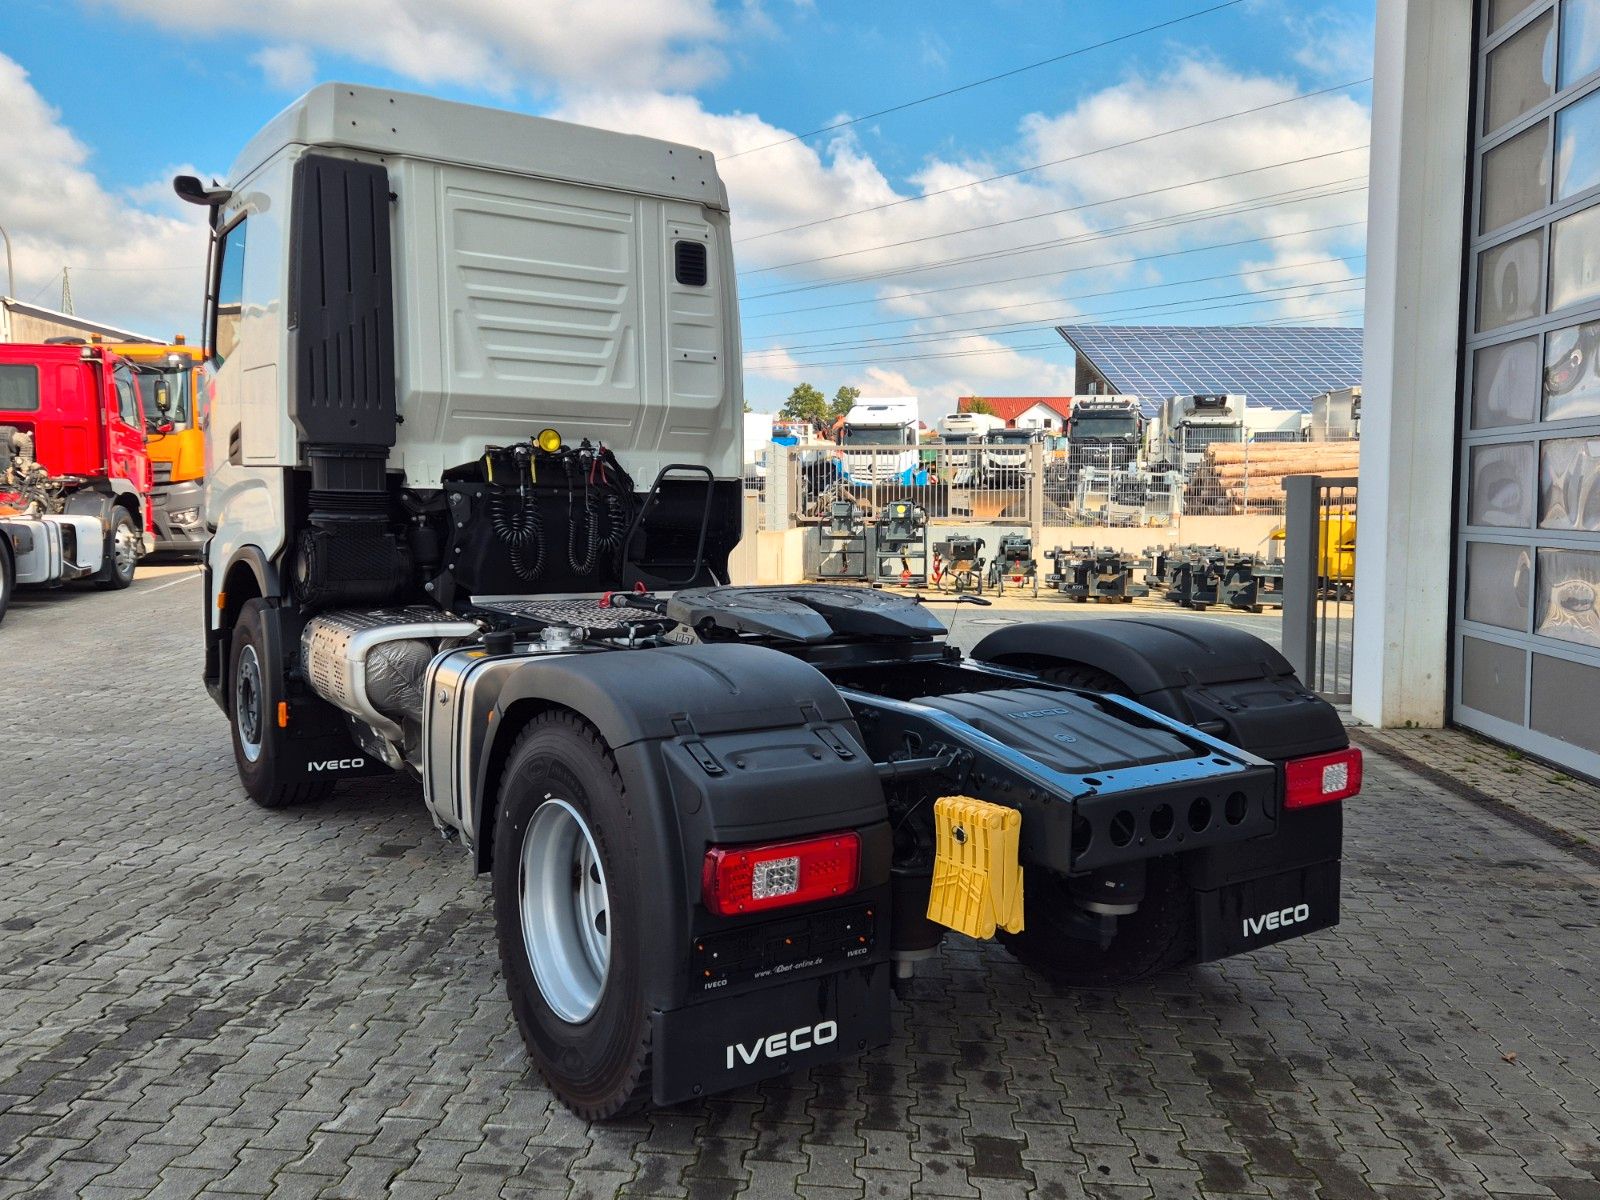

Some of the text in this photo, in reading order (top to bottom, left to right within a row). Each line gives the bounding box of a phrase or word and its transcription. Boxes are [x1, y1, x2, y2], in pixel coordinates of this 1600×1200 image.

[307, 758, 365, 772] IVECO
[1242, 903, 1310, 937] IVECO
[847, 947, 868, 958] IVECO
[704, 979, 728, 990] IVECO
[726, 1019, 838, 1069] IVECO
